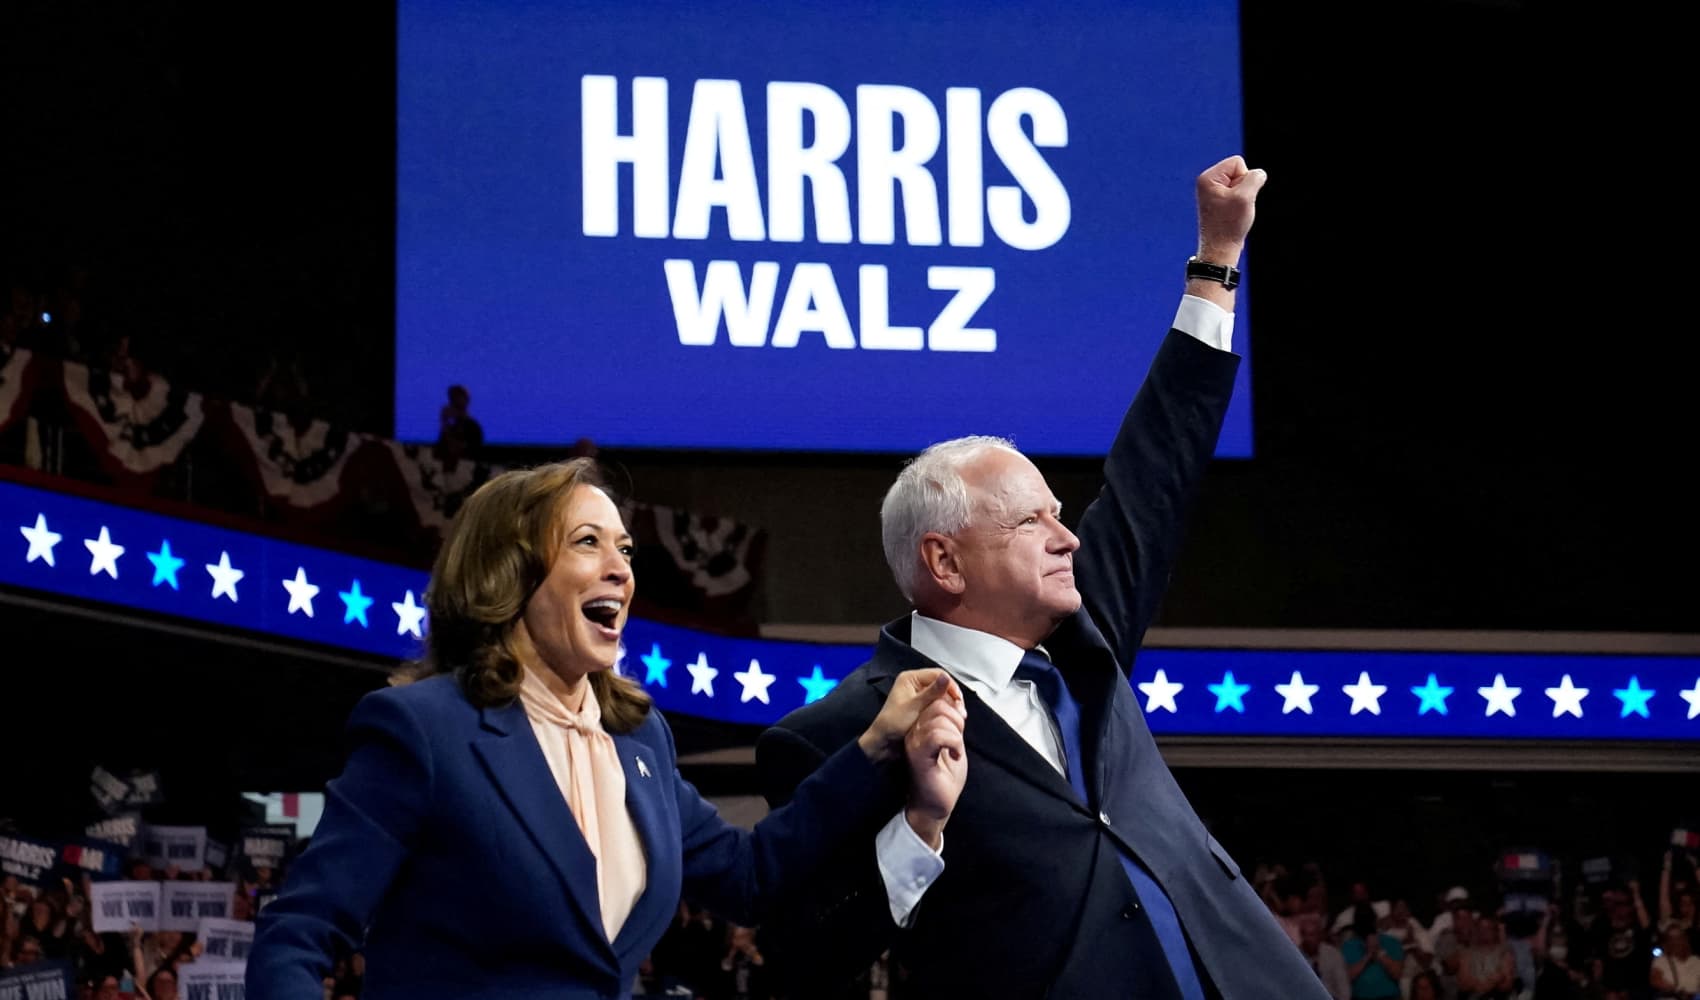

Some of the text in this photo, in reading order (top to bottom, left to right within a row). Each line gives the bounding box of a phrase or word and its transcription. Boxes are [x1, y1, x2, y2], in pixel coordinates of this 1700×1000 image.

[581, 75, 1072, 251] HARRIS
[663, 259, 997, 352] WALZ
[127, 900, 156, 918] WIN
[171, 899, 227, 918] WE WIN
